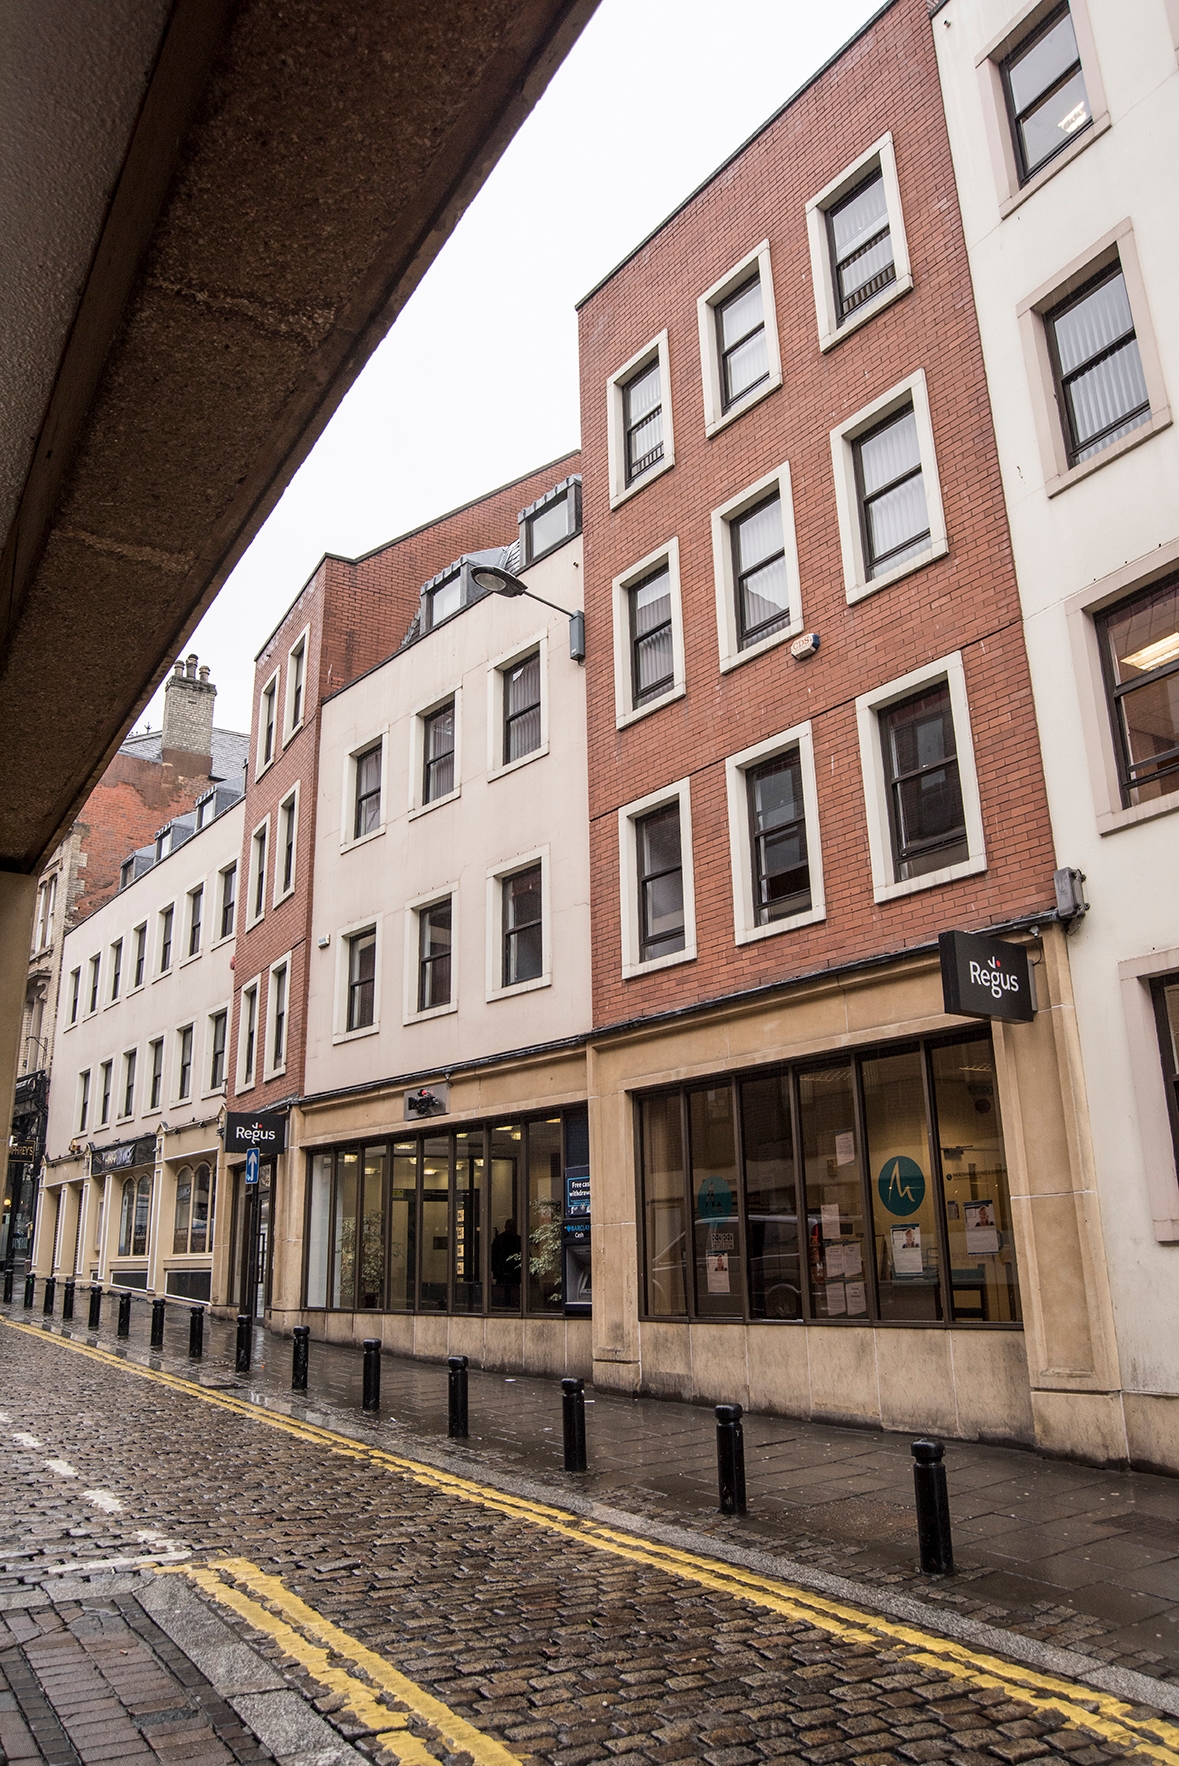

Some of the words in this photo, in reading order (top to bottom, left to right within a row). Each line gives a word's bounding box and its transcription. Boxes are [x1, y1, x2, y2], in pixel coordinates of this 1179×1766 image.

[793, 636, 810, 651] CDS
[969, 959, 1020, 999] Regus
[235, 1125, 276, 1144] Regus
